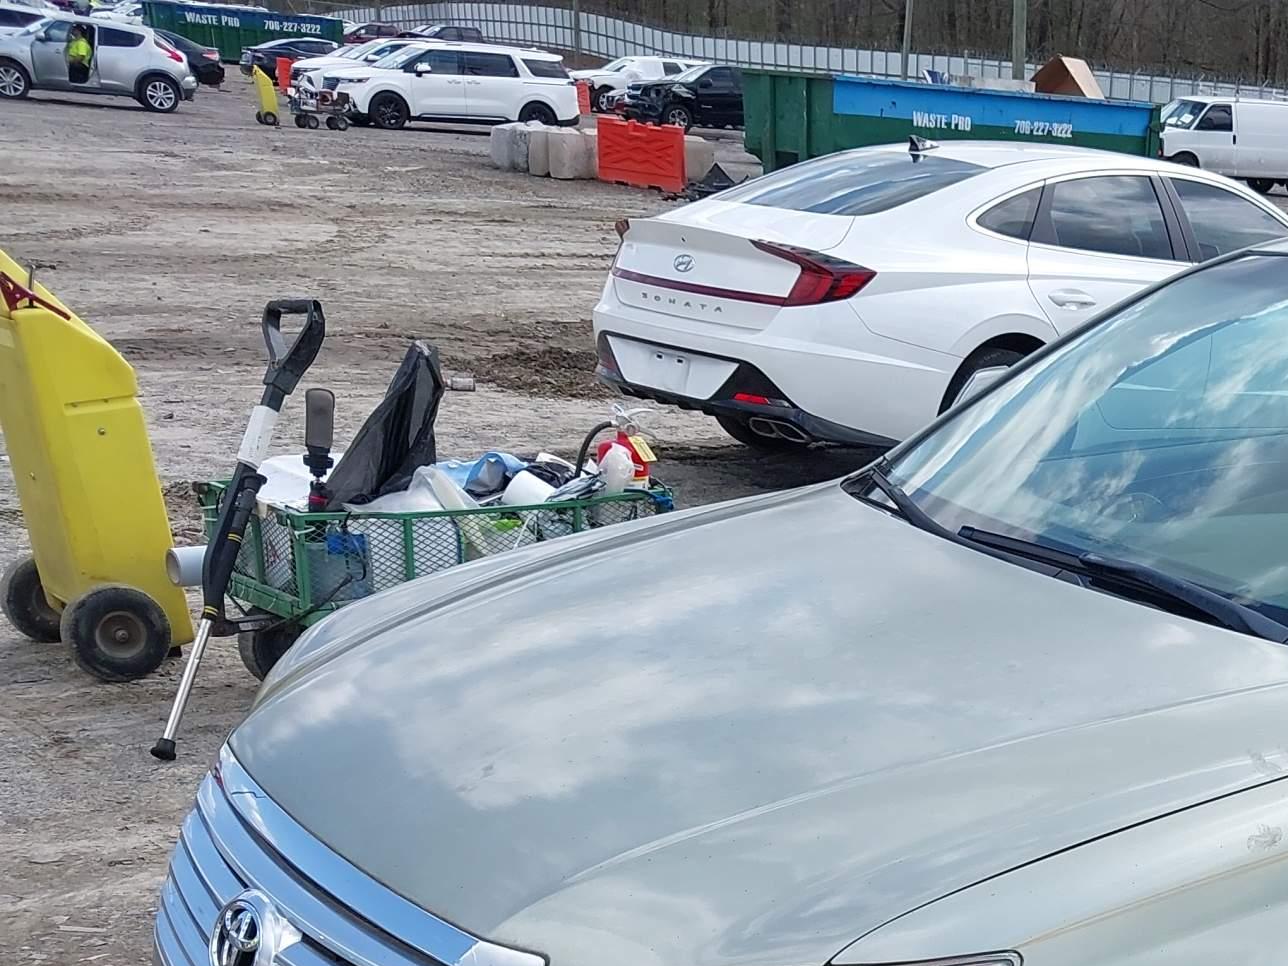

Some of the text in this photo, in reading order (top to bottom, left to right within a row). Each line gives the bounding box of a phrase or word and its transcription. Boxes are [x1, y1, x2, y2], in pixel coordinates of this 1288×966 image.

[185, 11, 240, 28] WASTE PRO
[264, 19, 321, 34] 706-227-3222
[912, 110, 971, 131] WASTE PRO
[642, 293, 722, 312] SONATA
